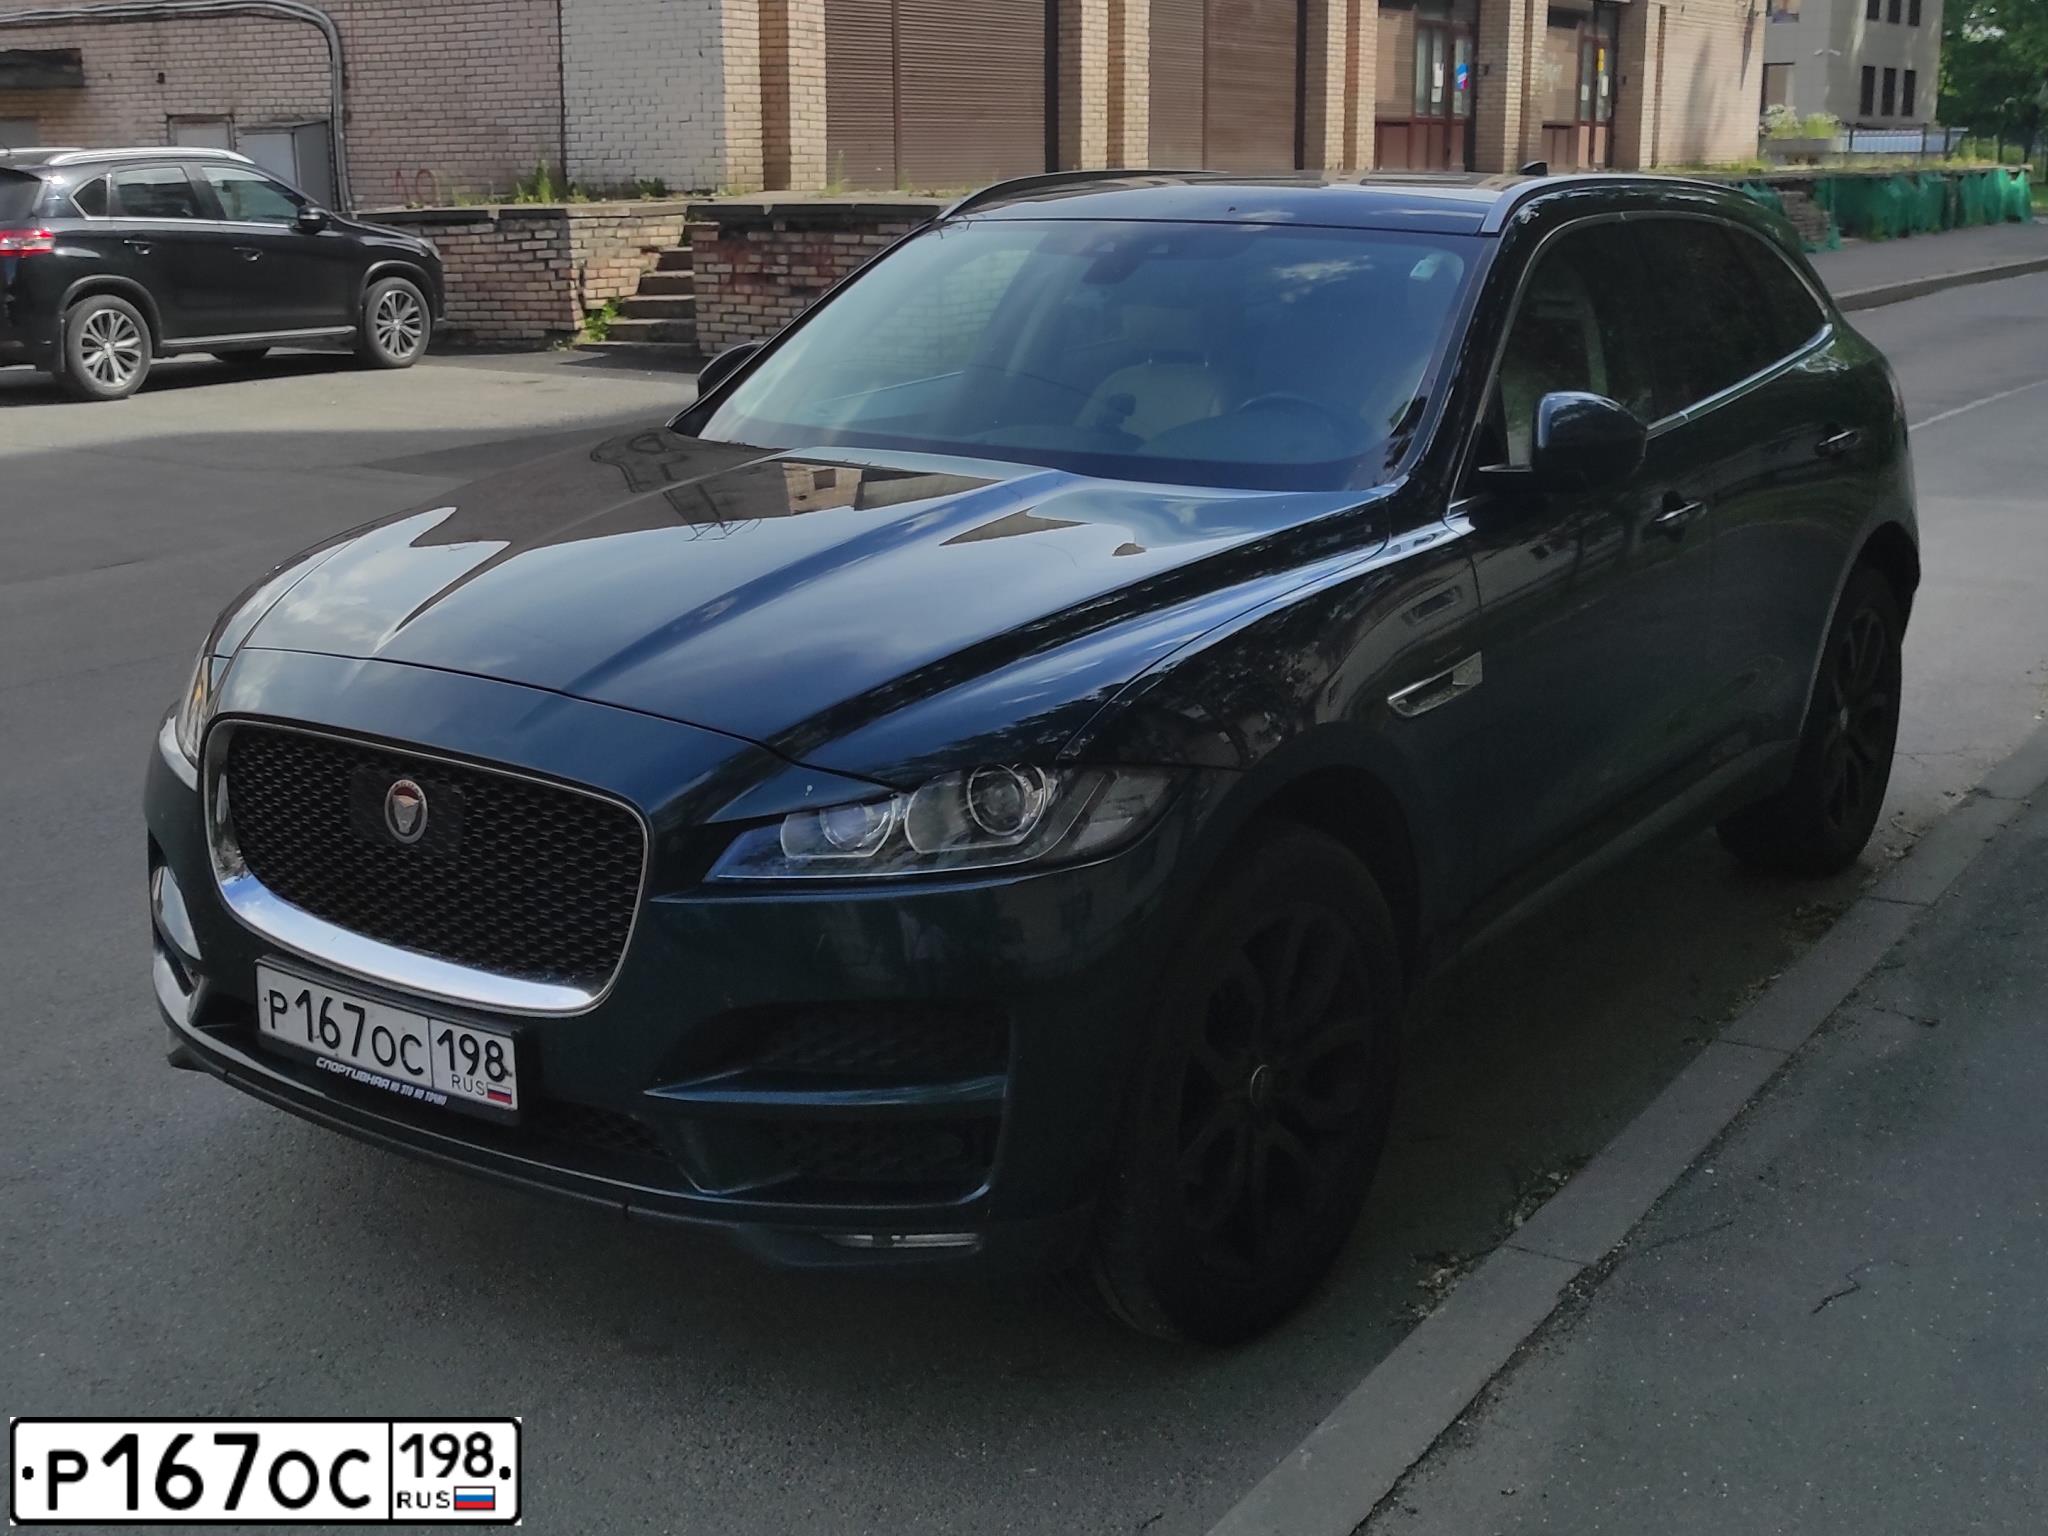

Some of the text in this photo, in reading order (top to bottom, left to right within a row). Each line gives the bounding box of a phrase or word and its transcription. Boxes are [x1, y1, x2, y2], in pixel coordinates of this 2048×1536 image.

[437, 1028, 506, 1083] 198
[316, 1057, 391, 1090] СПОРТИВНАЯ
[451, 1073, 486, 1096] RUS
